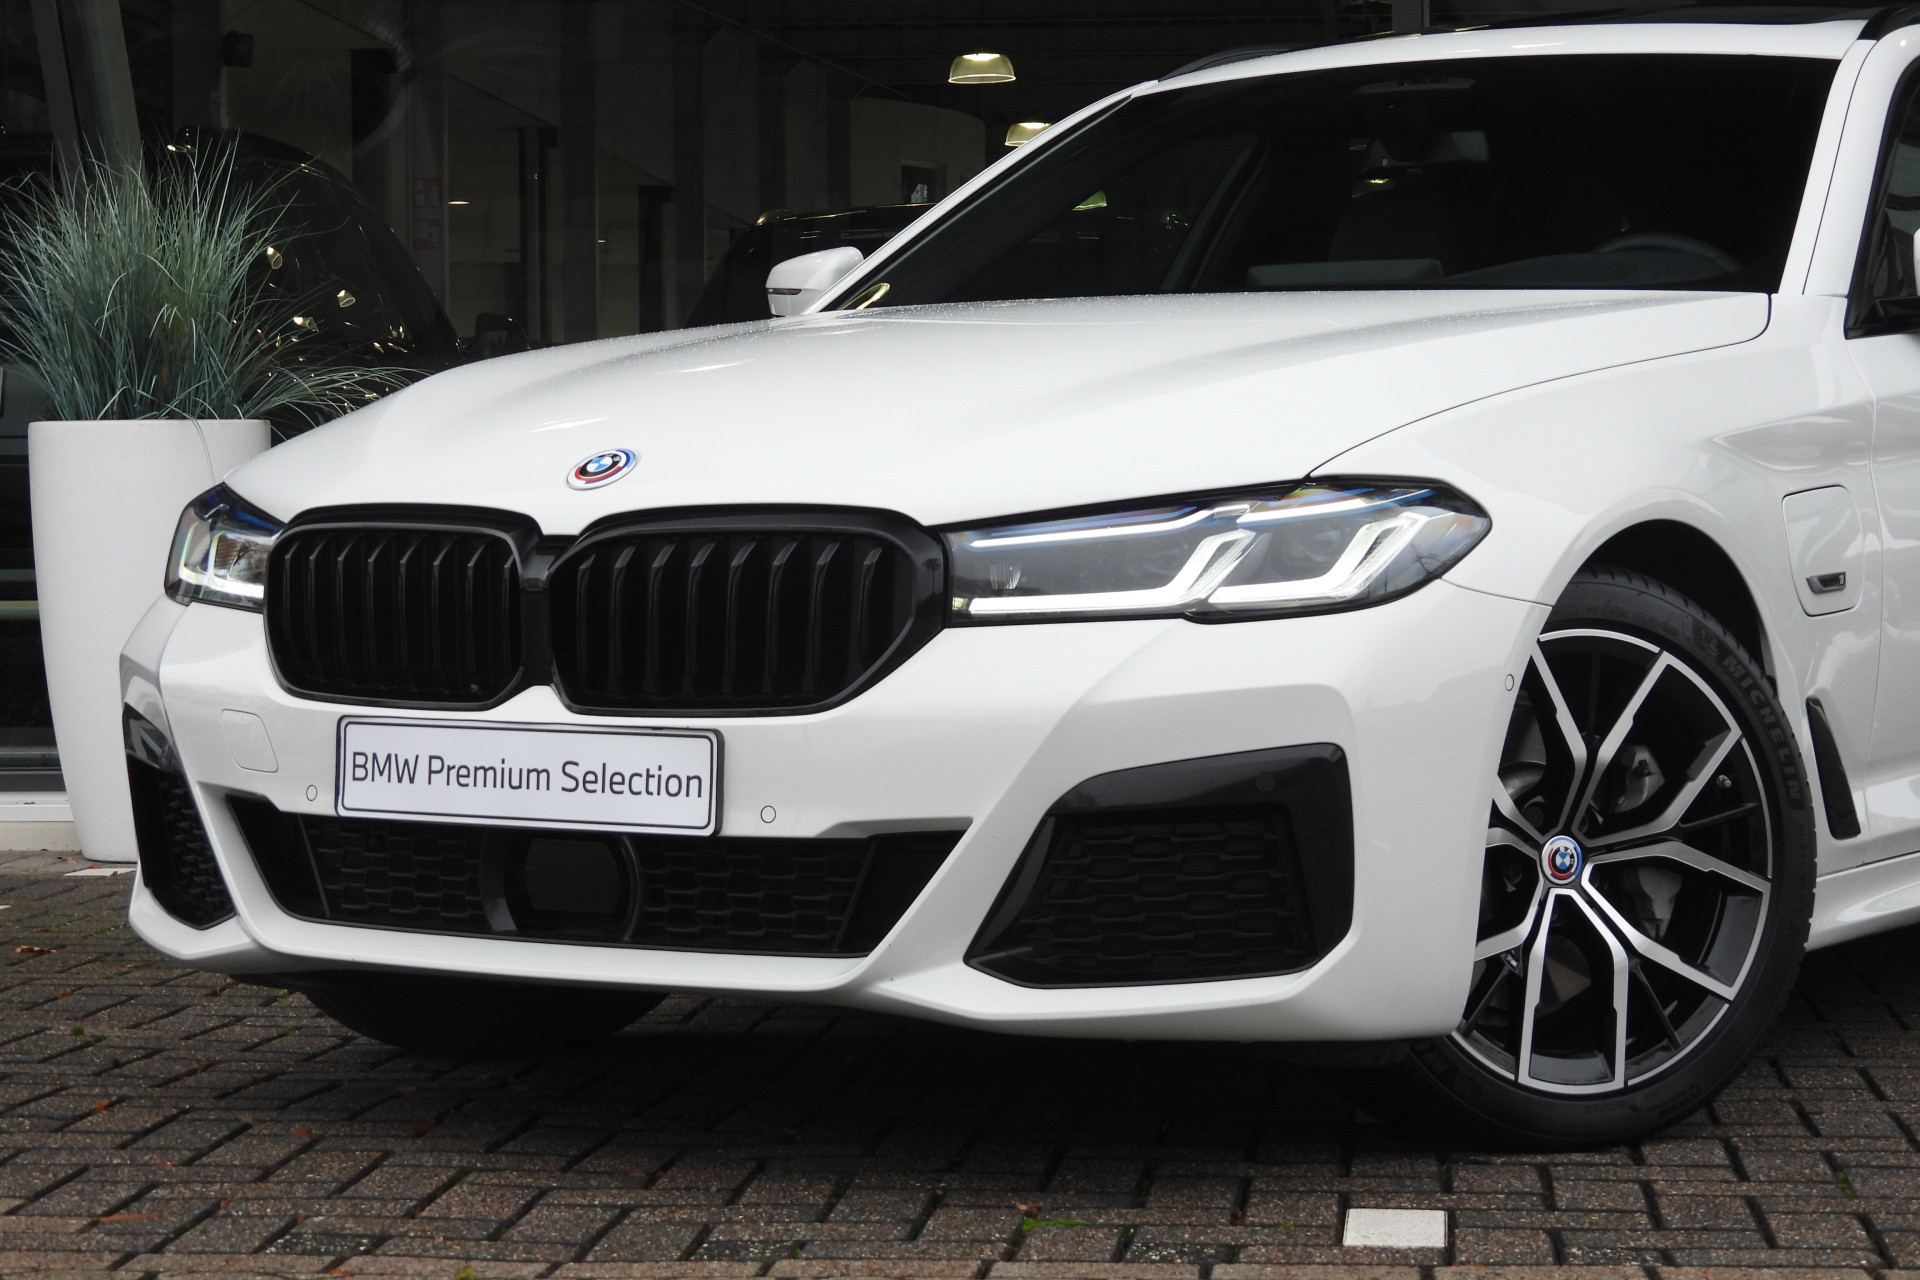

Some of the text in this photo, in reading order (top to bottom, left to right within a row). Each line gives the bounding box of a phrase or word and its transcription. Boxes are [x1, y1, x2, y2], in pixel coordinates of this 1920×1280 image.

[1723, 655, 1803, 798] MICHELIN
[352, 751, 703, 799] BMW Premium Selection
